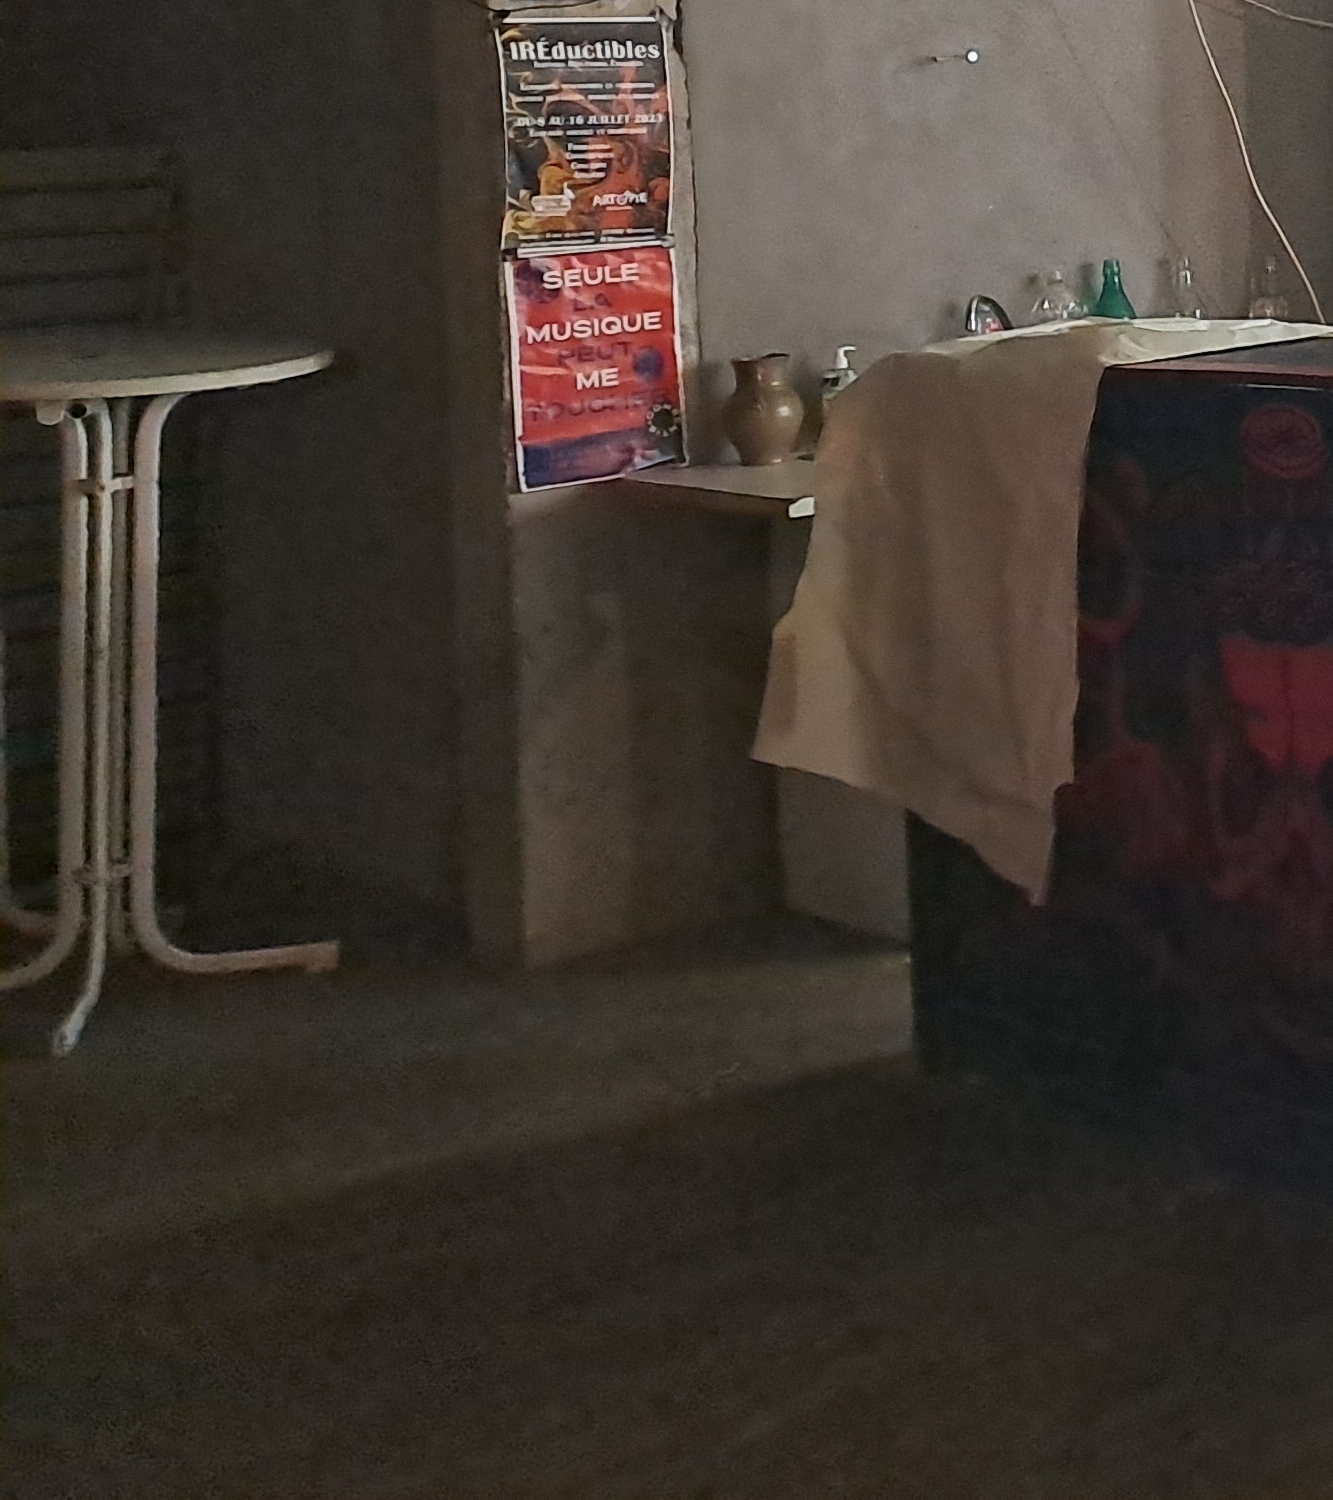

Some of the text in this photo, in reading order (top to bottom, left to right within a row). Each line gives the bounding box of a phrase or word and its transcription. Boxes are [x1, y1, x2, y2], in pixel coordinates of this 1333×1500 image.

[510, 36, 661, 61] IRÉductibles
[569, 114, 585, 125] 16
[543, 262, 640, 290] SEULE
[573, 293, 612, 312] LA
[525, 311, 663, 345] MUSIQUE
[557, 341, 630, 365] PEUT
[576, 367, 620, 391] ME
